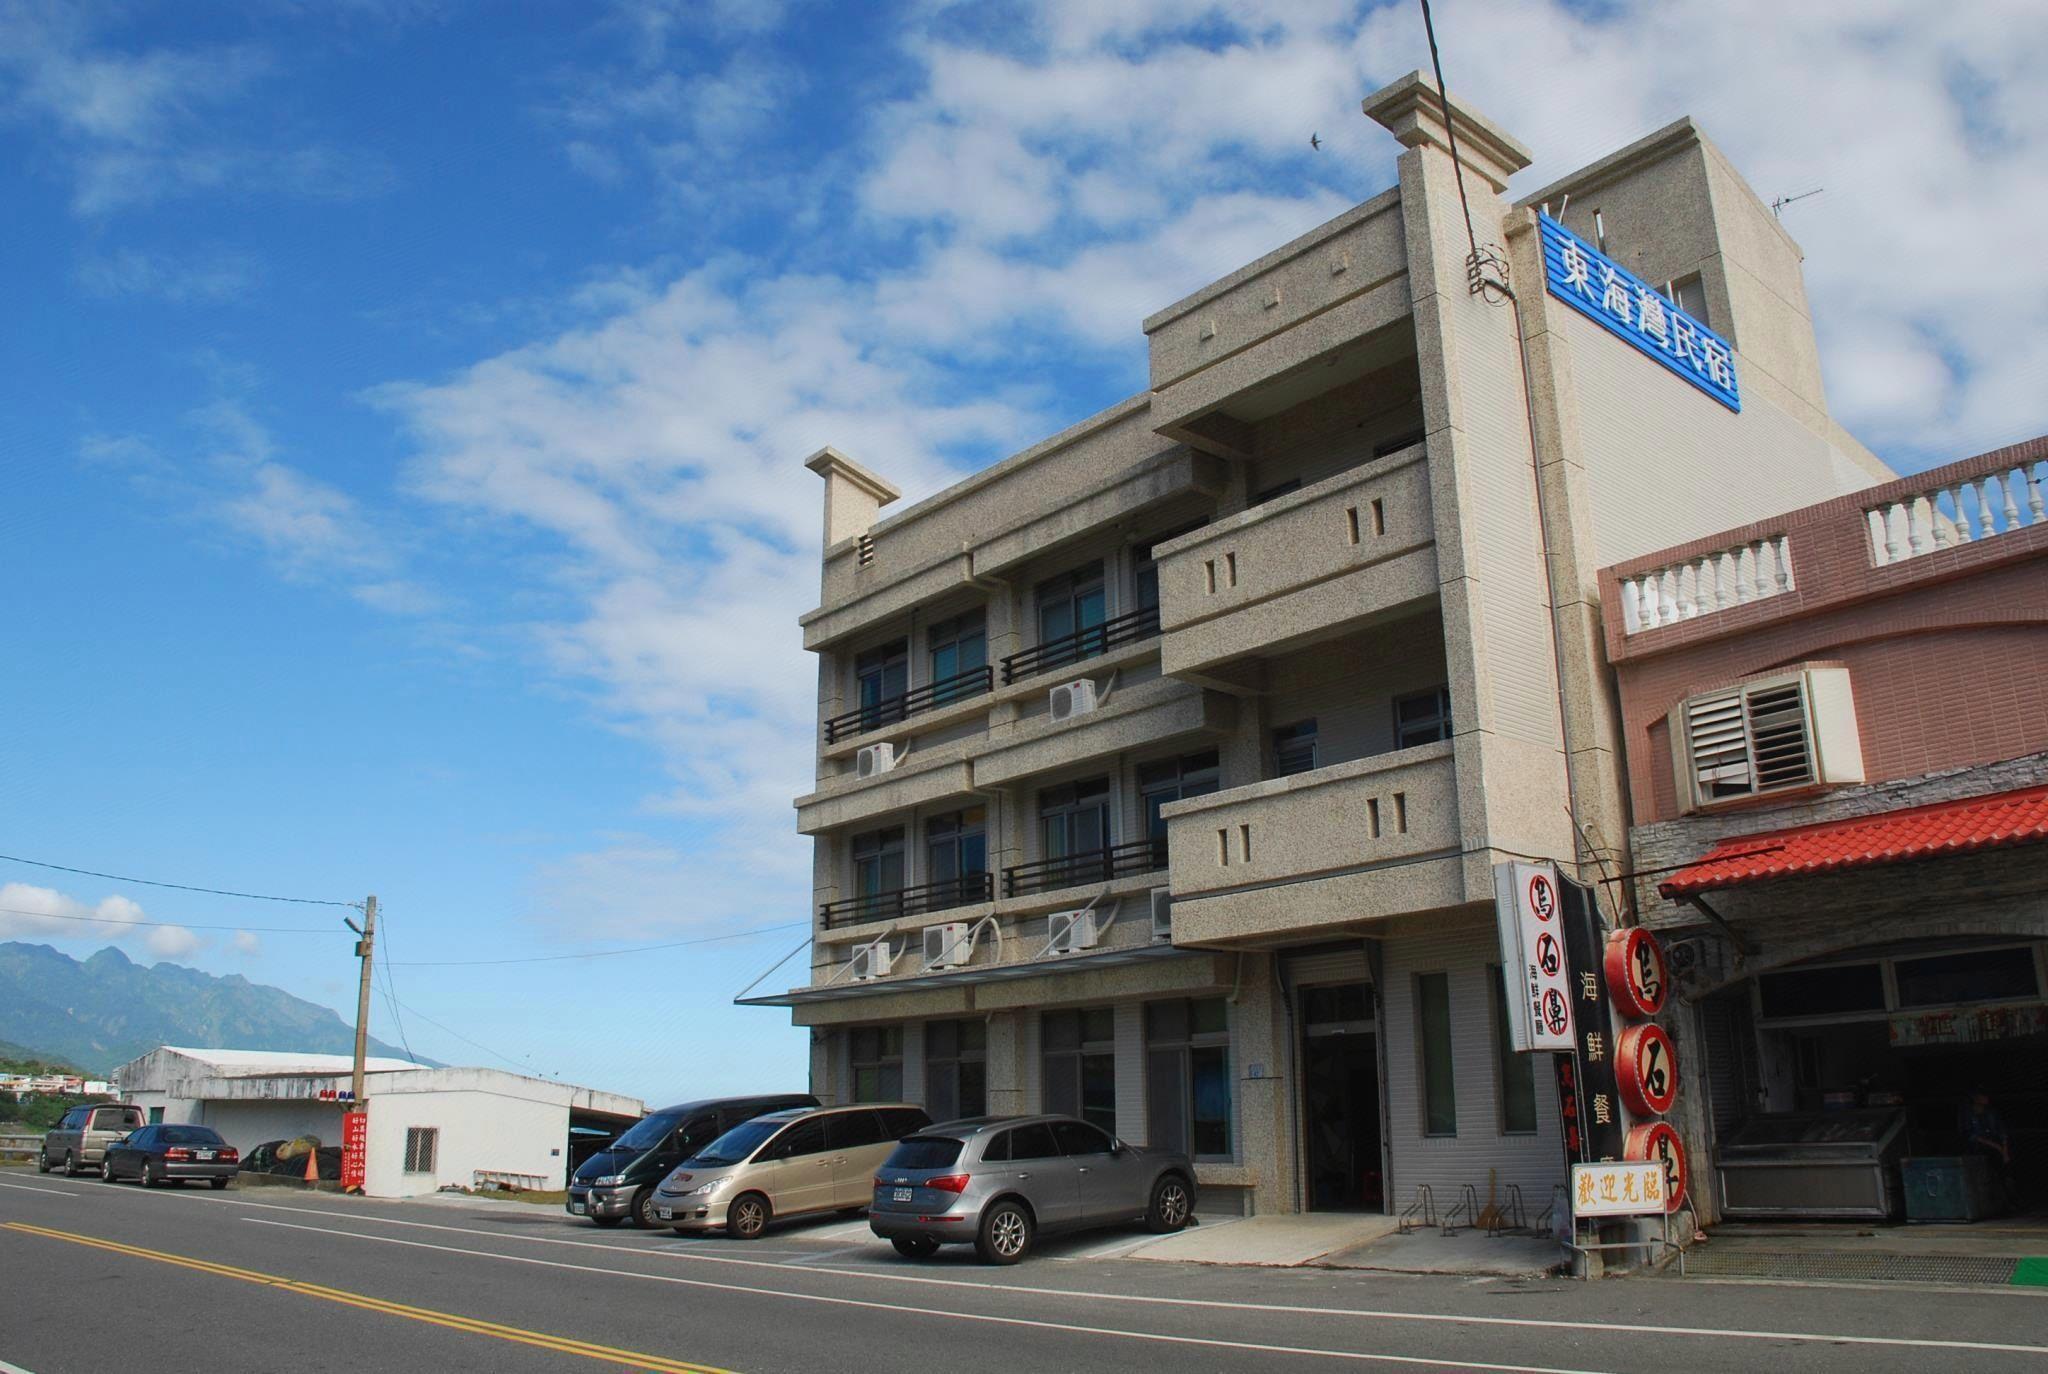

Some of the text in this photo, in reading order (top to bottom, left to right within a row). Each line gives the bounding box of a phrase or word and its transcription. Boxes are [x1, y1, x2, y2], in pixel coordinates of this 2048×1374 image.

[1556, 236, 1730, 390] 東海灣民宿
[1580, 971, 1615, 1162] 海鮮餐
[1577, 1172, 1661, 1206] 歡迎光臨
